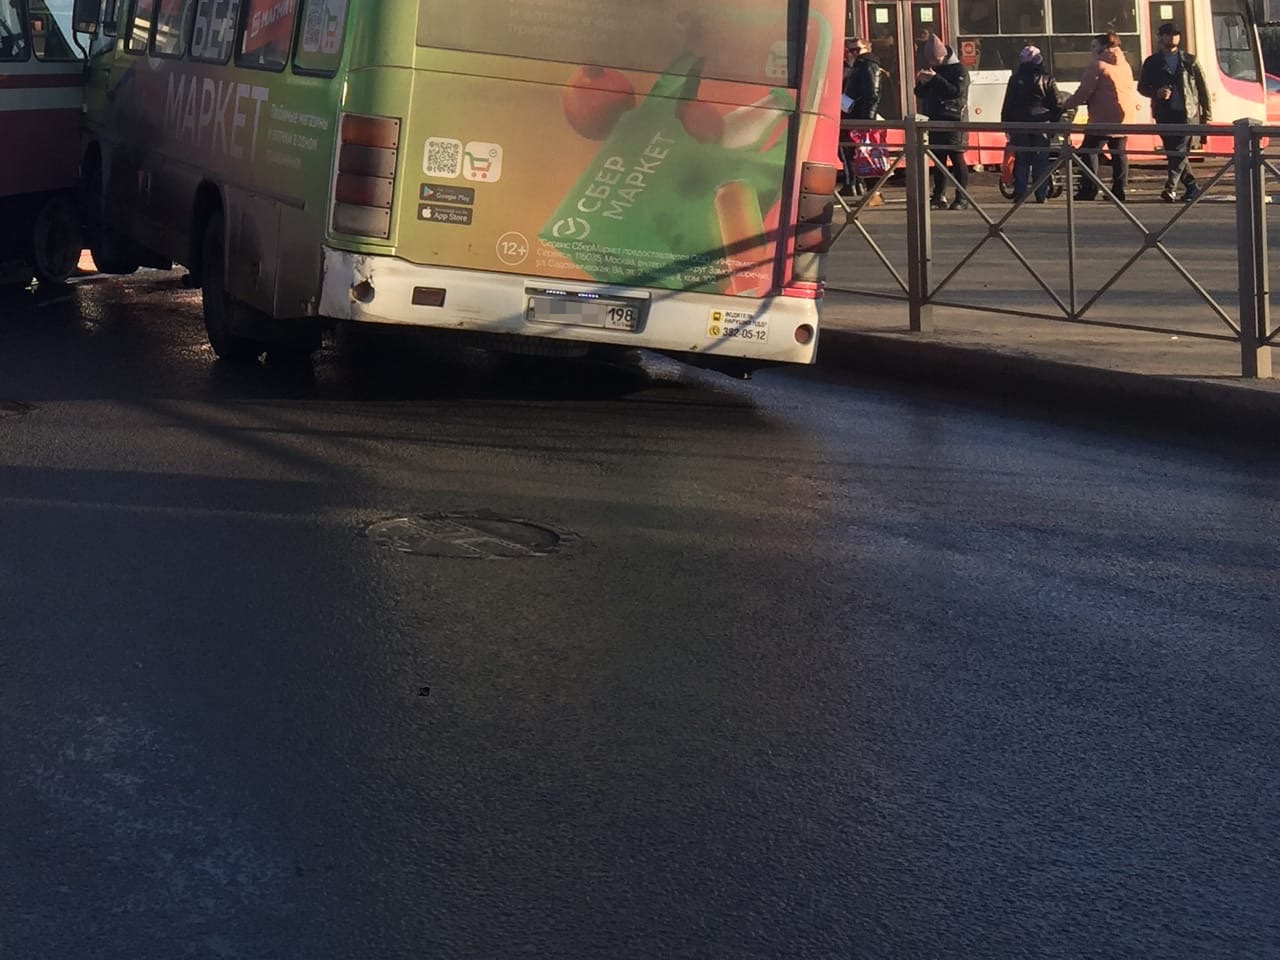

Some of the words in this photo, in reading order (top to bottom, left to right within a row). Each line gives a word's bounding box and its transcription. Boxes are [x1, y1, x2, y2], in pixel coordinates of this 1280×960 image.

[164, 71, 270, 162] МАРКЕТ
[602, 131, 675, 220] МАРКЕТ
[577, 156, 625, 213] СБЕР
[433, 211, 448, 221] App
[448, 213, 468, 223] Store
[501, 241, 527, 256] 12+
[608, 307, 633, 321] 198
[722, 326, 767, 341] 382-05-12
